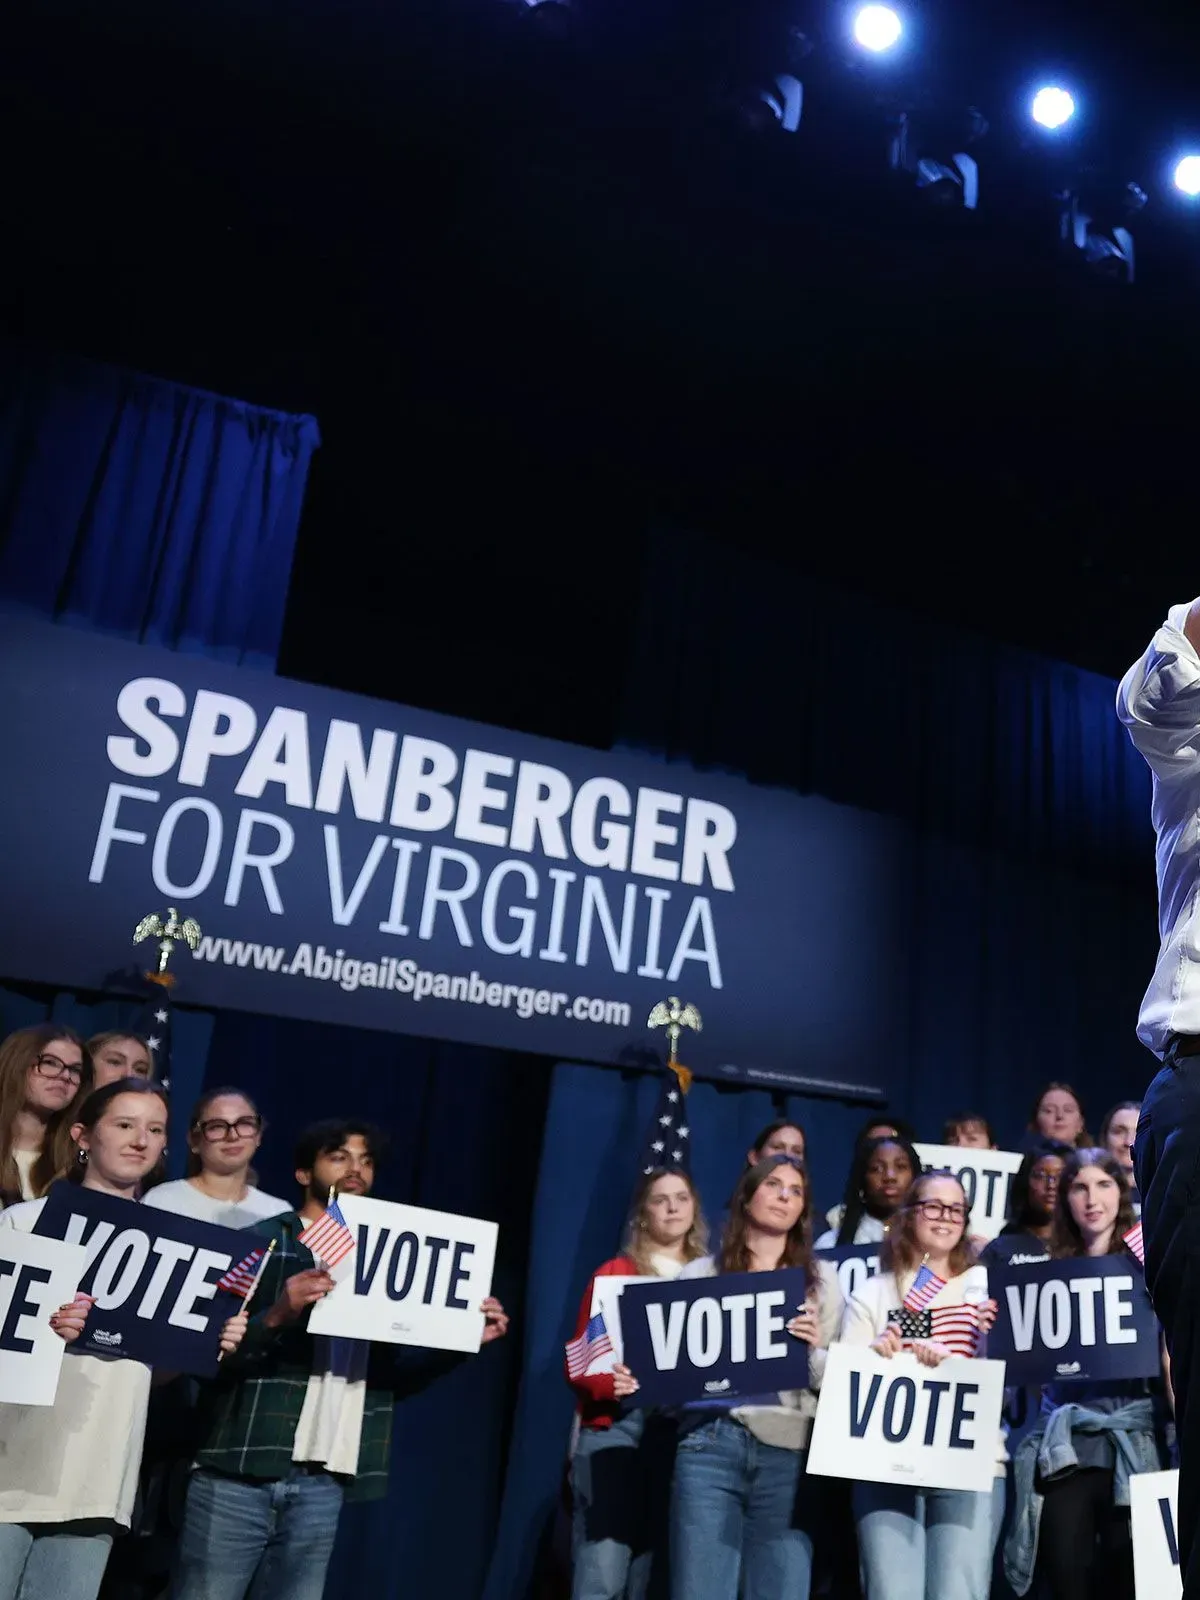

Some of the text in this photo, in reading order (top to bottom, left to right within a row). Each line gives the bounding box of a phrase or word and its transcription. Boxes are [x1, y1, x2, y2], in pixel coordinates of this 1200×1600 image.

[106, 676, 738, 892] SPANBERGER
[88, 781, 724, 990] FOR VIRGINIA
[192, 935, 631, 1026] www.AbigailSpanberger.com
[68, 1213, 233, 1333] VOTE
[353, 1223, 476, 1310] VOTE
[644, 1289, 790, 1372] VOTE
[1004, 1274, 1138, 1352] VOTE
[847, 1370, 979, 1450] VOTE
